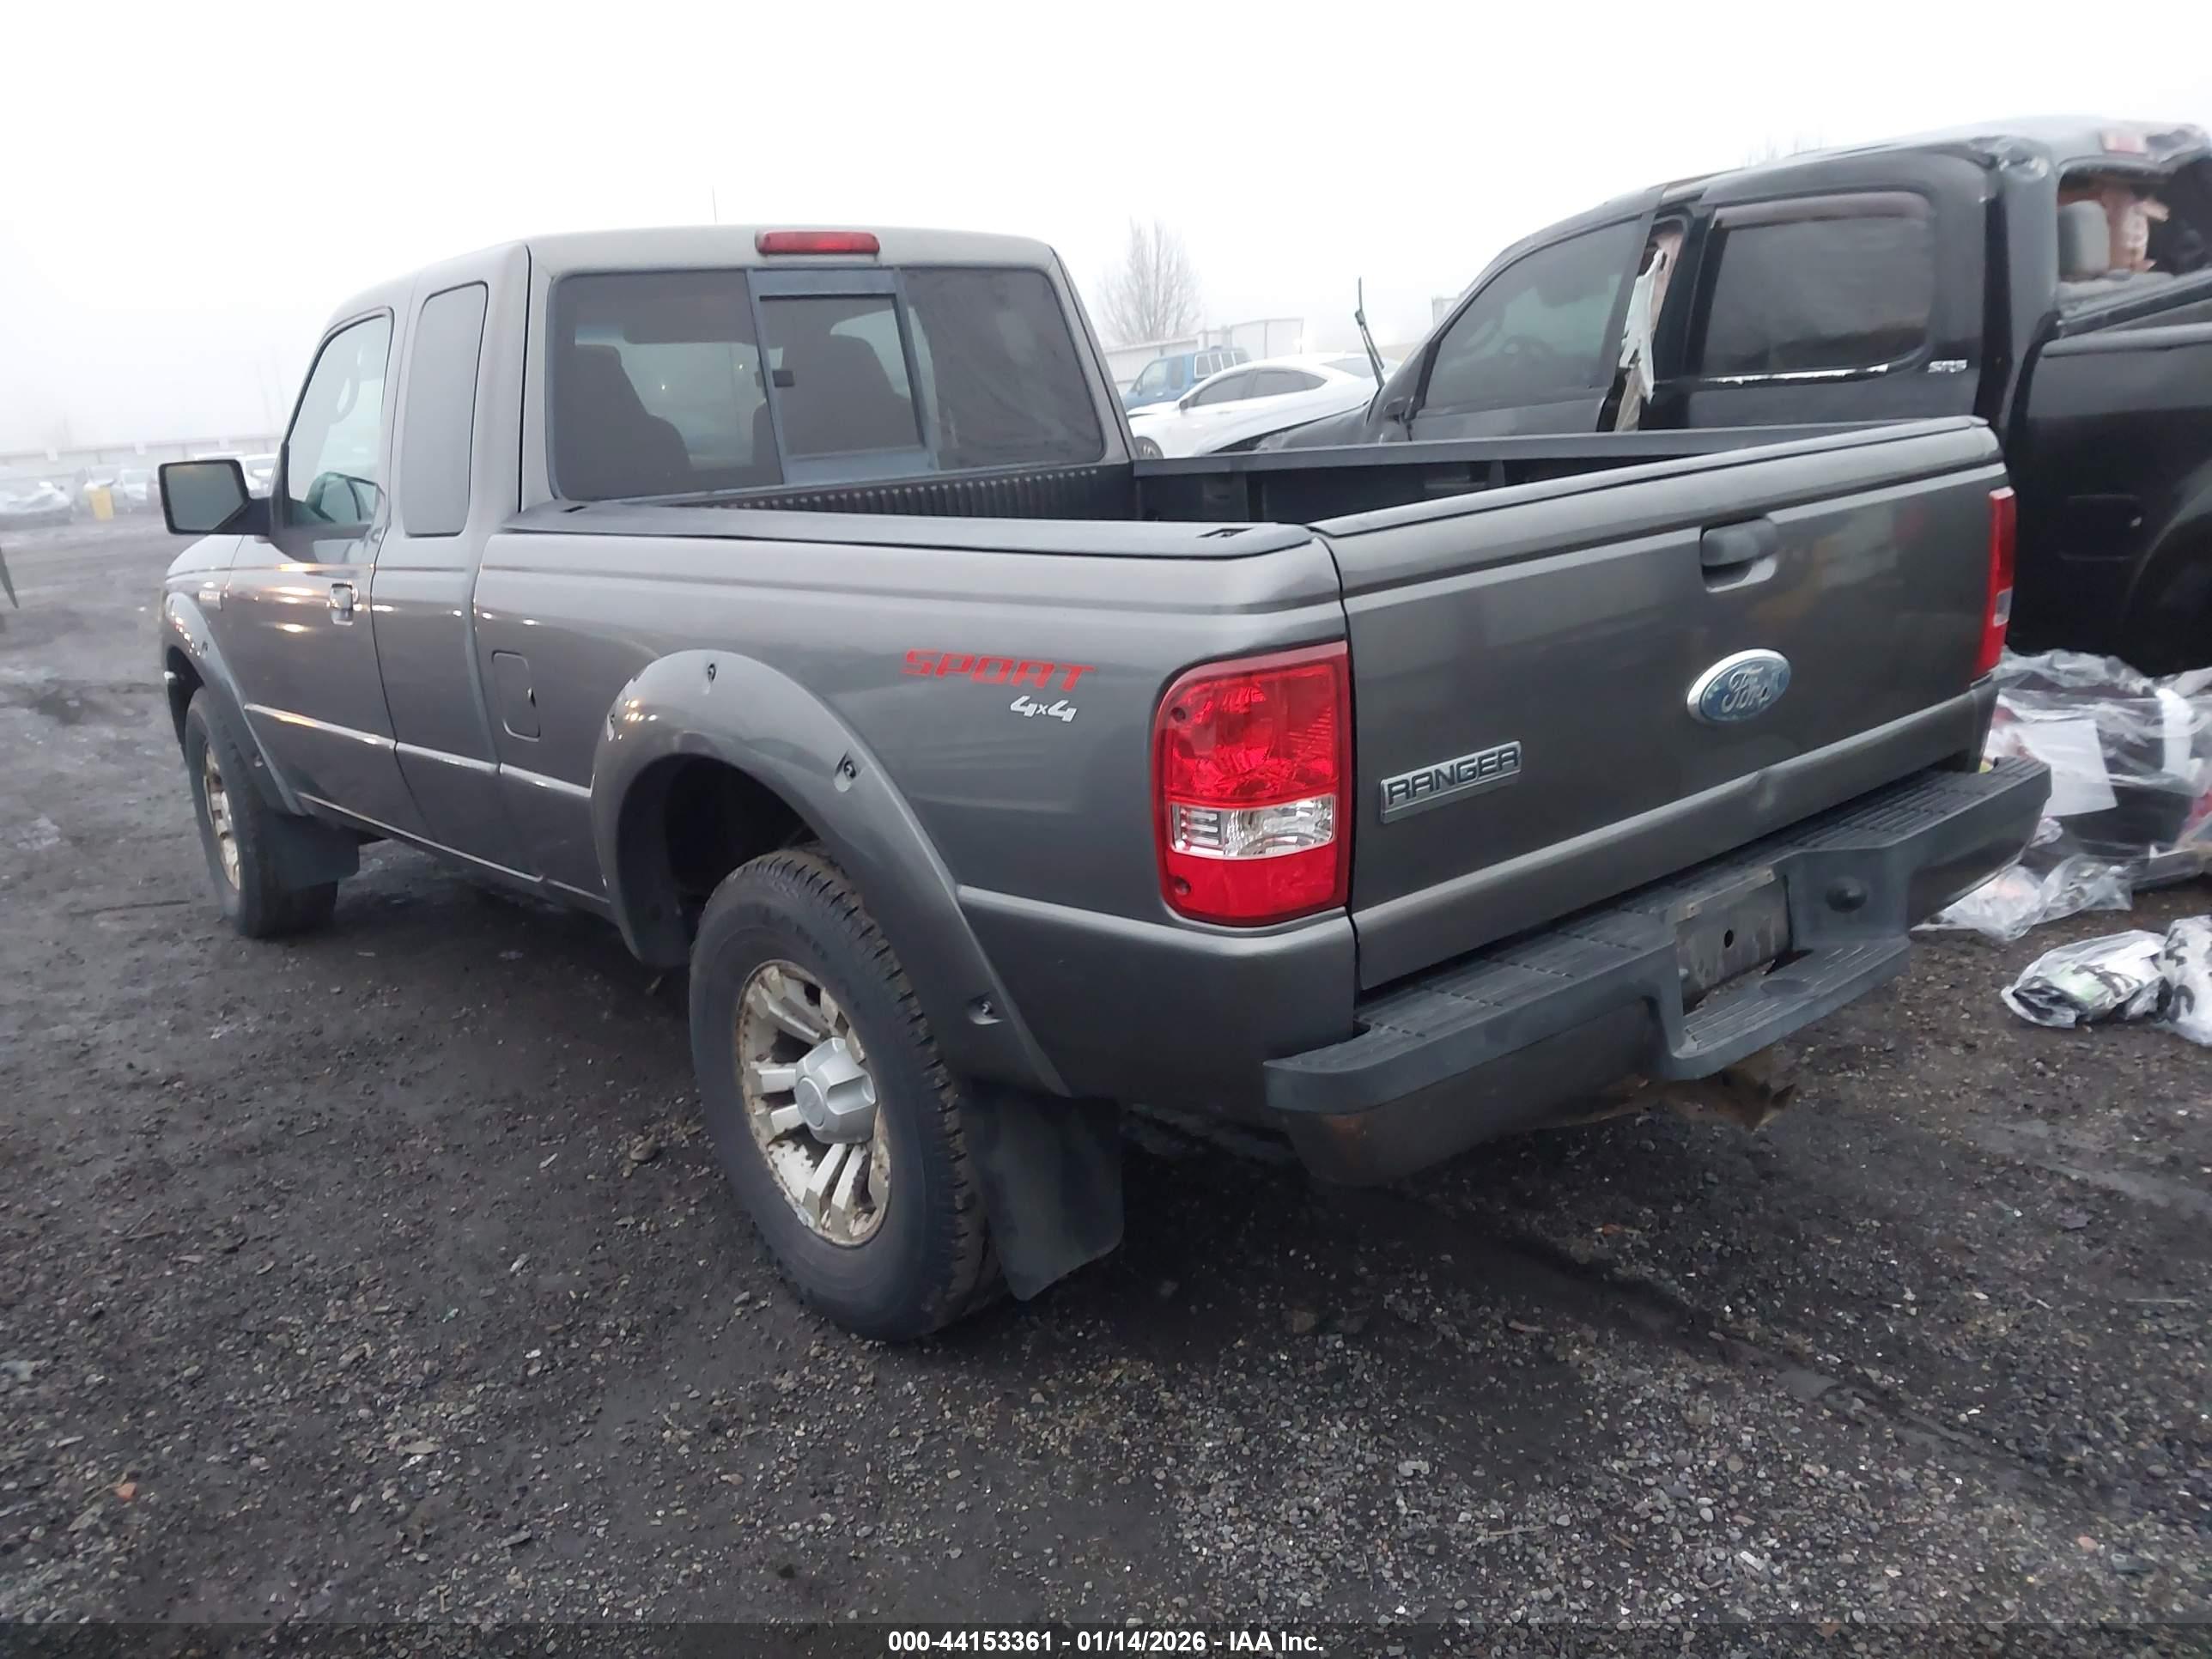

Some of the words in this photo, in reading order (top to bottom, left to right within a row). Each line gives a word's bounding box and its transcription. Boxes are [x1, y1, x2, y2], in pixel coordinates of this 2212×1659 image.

[901, 648, 1097, 692] SPORT
[1721, 665, 1778, 714] Ford
[1009, 695, 1078, 723] 4x4
[1387, 746, 1520, 805] RANGER
